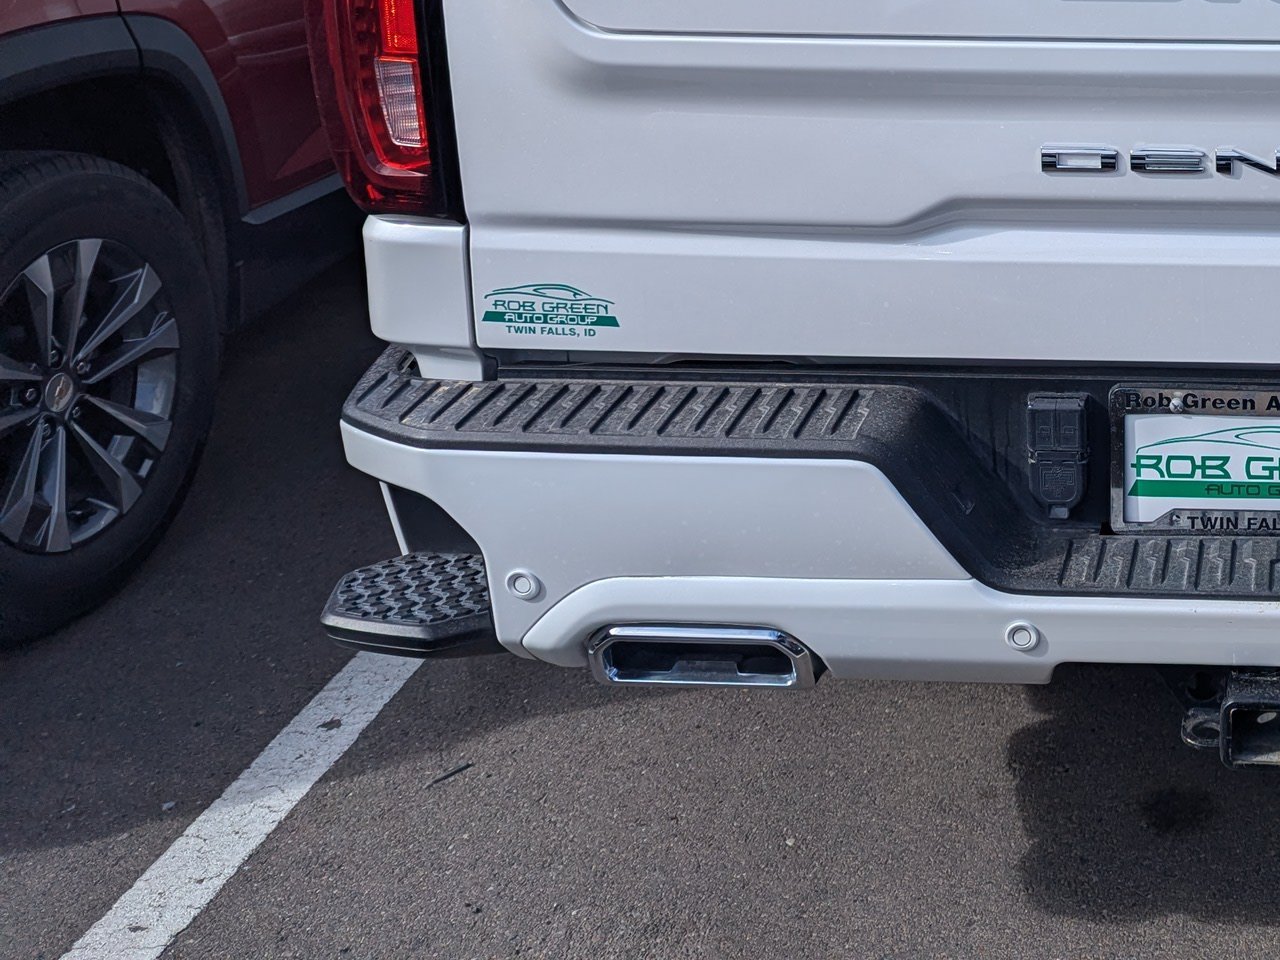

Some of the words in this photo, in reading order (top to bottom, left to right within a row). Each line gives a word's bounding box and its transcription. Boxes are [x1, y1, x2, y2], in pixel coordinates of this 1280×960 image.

[492, 300, 536, 311] ROB
[541, 302, 609, 314] GREEN
[503, 313, 544, 323] AUTO
[547, 315, 598, 325] GROUP
[506, 325, 536, 335] TWIN
[540, 327, 580, 337] FALLS,
[584, 328, 596, 336] ID
[1124, 392, 1172, 409] Rob
[1182, 393, 1257, 411] Green
[1130, 455, 1231, 479] ROB
[1205, 484, 1261, 496] AUTO
[1187, 516, 1238, 530] TWIN
